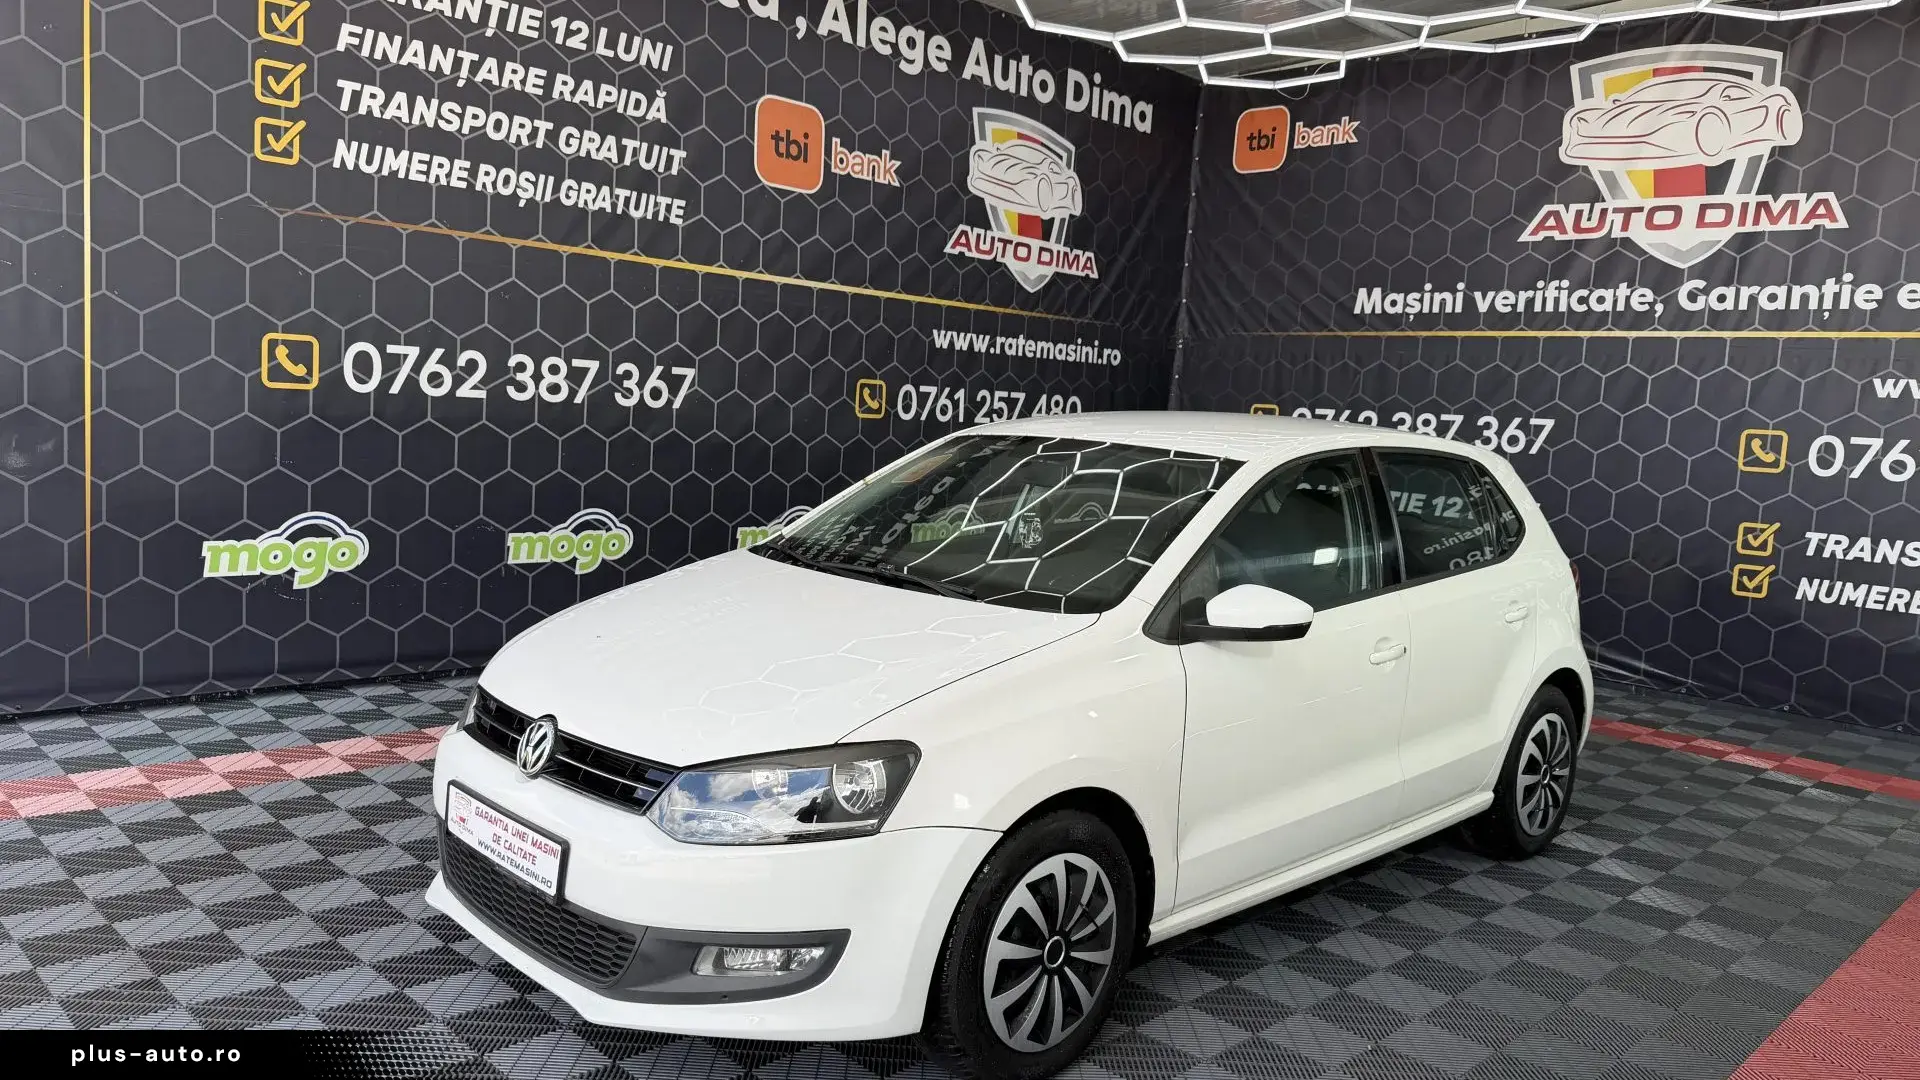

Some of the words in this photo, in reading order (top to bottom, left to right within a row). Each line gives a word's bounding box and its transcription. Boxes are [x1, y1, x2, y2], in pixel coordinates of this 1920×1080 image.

[550, 15, 590, 50] 12
[595, 26, 674, 72] LUNI
[816, 0, 952, 75] Alege
[962, 37, 1055, 103] Auto
[1066, 68, 1154, 134] Dima
[335, 23, 547, 95] FINANȚARE
[552, 73, 669, 124] RAPIDĂ
[335, 79, 553, 148] TRANSPORT
[558, 125, 687, 175] GRATUIT
[770, 129, 809, 164] tbi
[1246, 126, 1276, 152] tbi
[1294, 116, 1361, 150] bank
[332, 138, 470, 187] NUMERE
[475, 162, 553, 207] ROȘII
[559, 178, 687, 225] GRATUITE
[832, 138, 900, 186] bank
[1528, 204, 1683, 237] AUTO
[1695, 197, 1839, 230] DIMA
[950, 229, 1032, 263] AUTO
[1036, 248, 1095, 276] DIMA
[1353, 283, 1464, 322] Mașini
[1474, 280, 1664, 317] verificate,
[1677, 273, 1883, 320] Garanție
[932, 329, 1121, 366] www.ratemasini.ro
[343, 341, 487, 398] 0762
[506, 354, 600, 404] 387
[614, 362, 696, 409] 367
[897, 383, 965, 423] 0761
[973, 389, 1026, 423] 257
[1474, 416, 1556, 454] 367
[206, 536, 361, 588] mogo
[510, 531, 627, 573] mogo
[474, 806, 509, 834] GARANTIA
[511, 825, 529, 843] UNEI
[531, 836, 560, 860] MASINI
[492, 833, 502, 845] DE
[503, 839, 537, 866] CALITATE
[477, 838, 553, 889] WWW.RATEMASINI.RO
